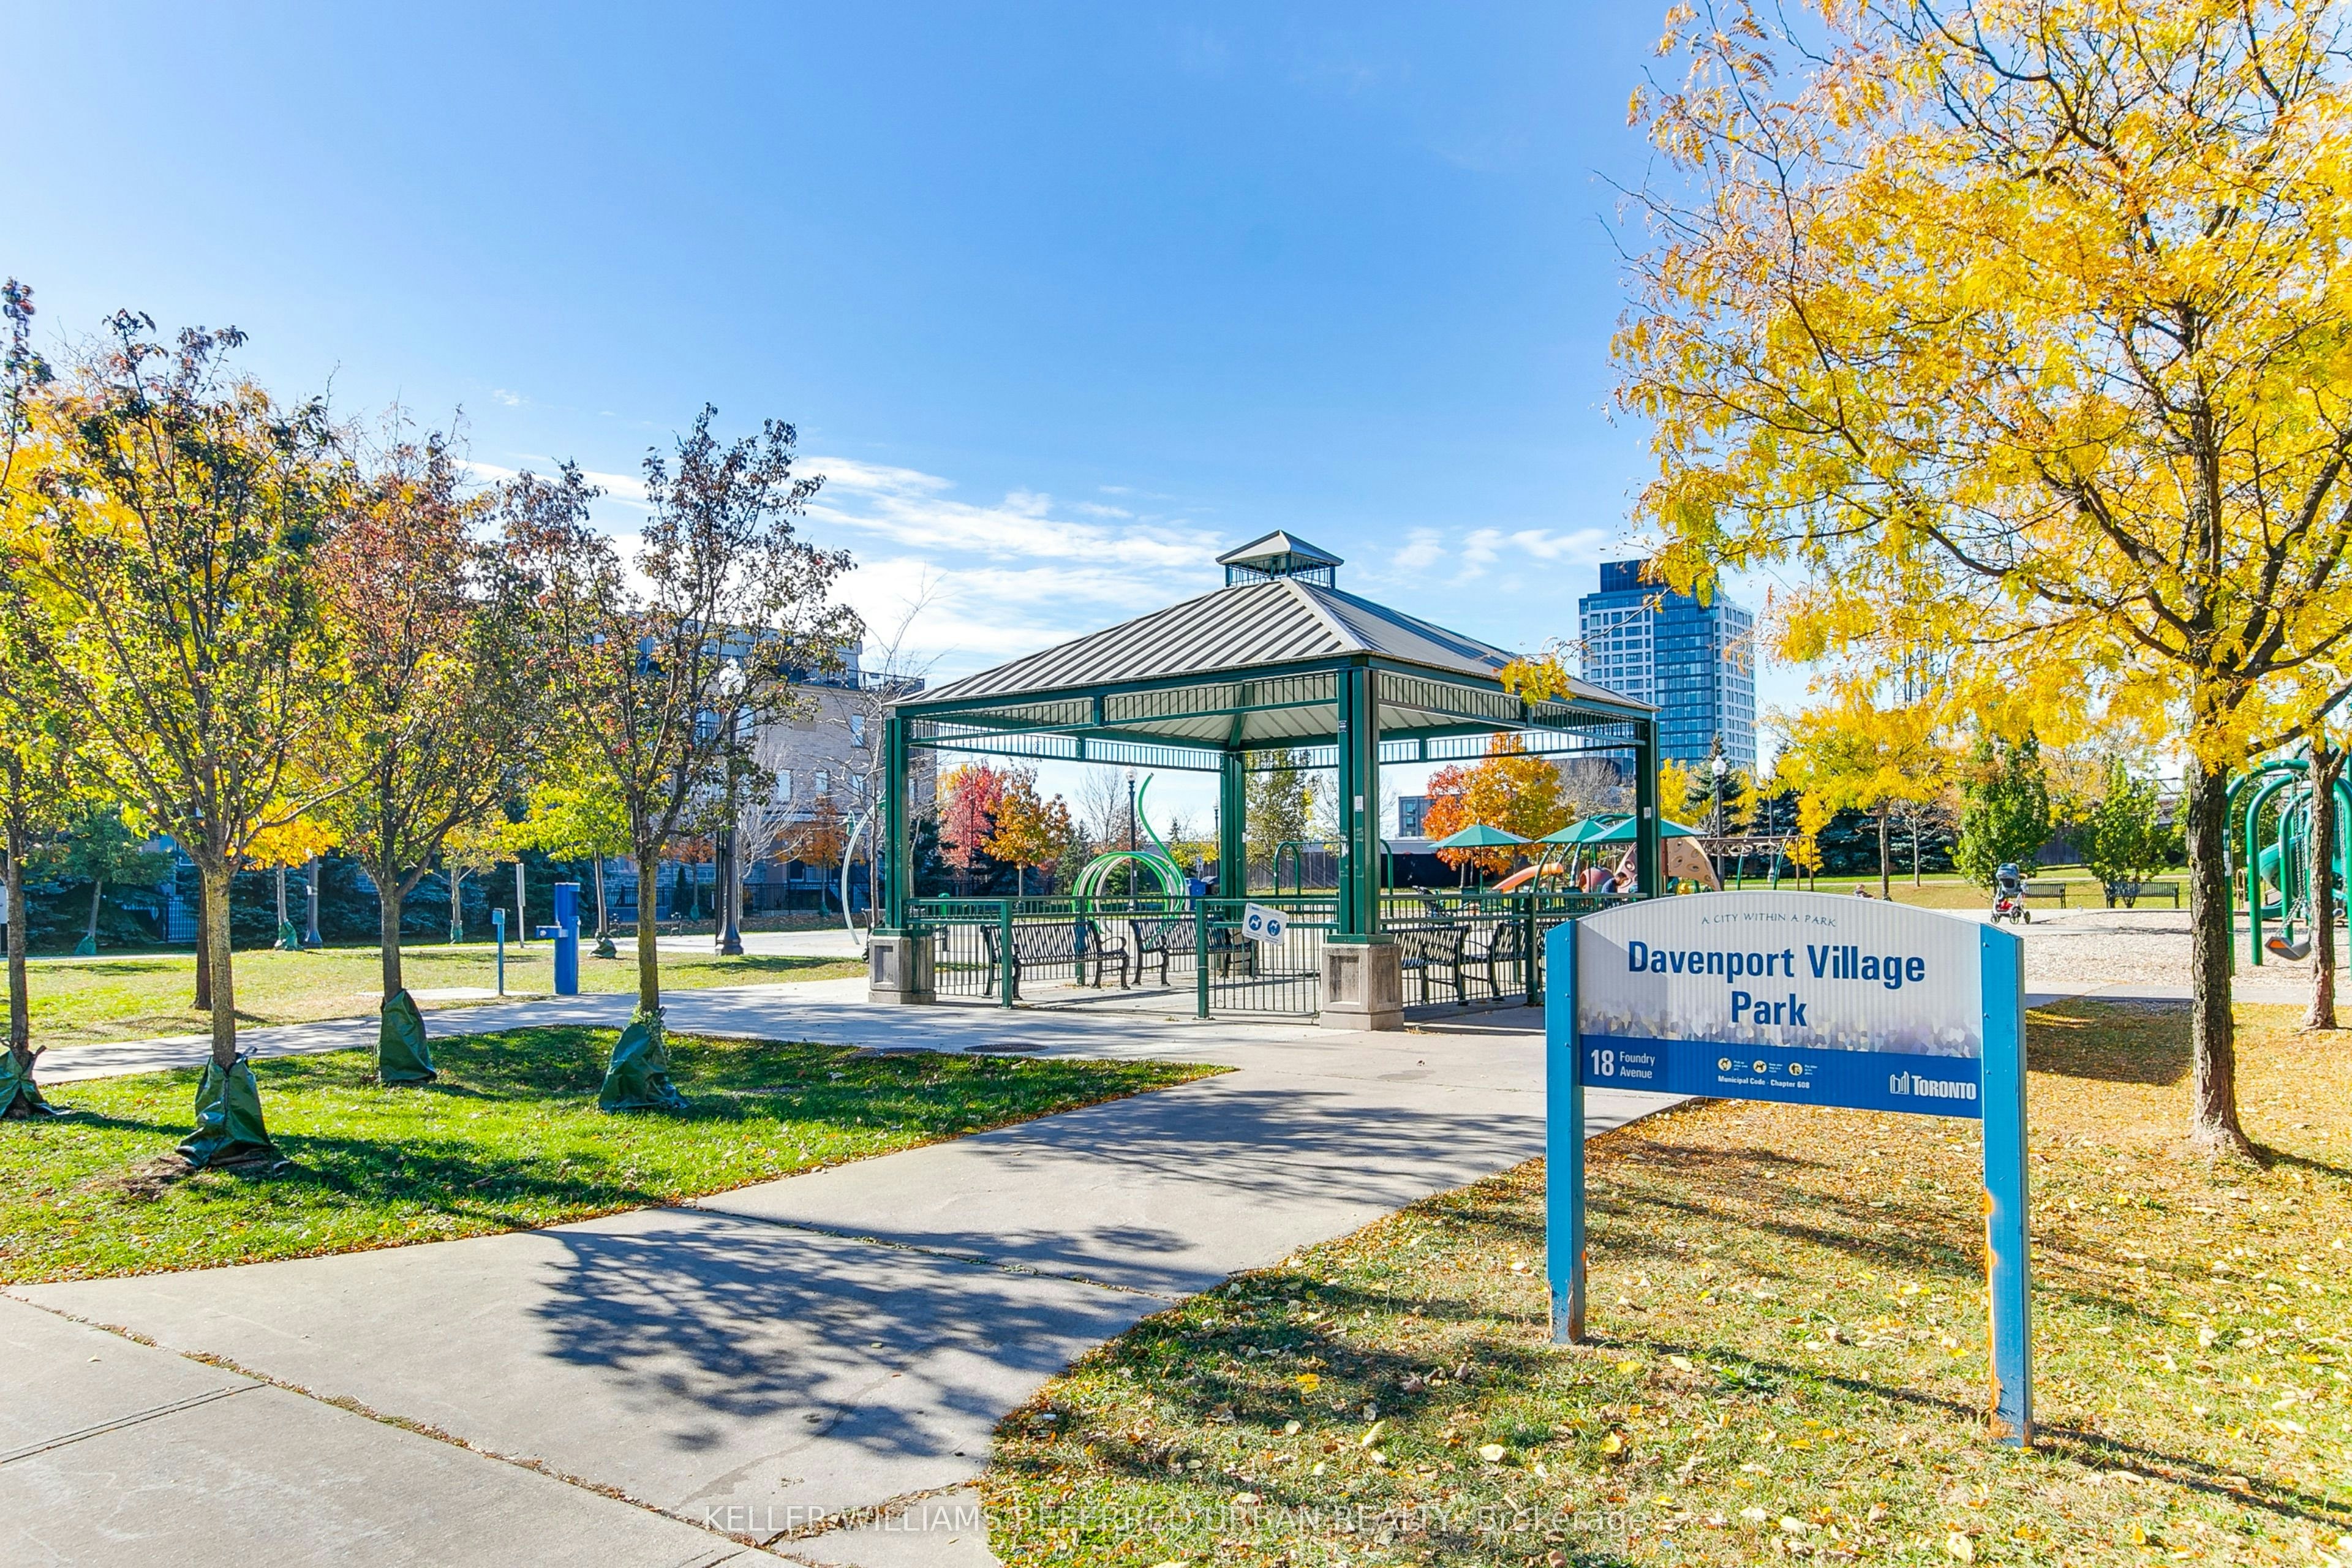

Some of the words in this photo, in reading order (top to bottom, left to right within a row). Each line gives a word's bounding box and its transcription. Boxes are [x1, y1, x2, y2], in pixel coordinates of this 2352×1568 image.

[1714, 914, 1738, 923] CITY
[1744, 913, 1785, 921] WITHIN
[1804, 915, 1836, 927] PARK
[1629, 941, 1795, 984] Davenport
[1807, 944, 1925, 990] Village
[1732, 990, 1807, 1027] Park
[1591, 1049, 1614, 1076] 18
[1619, 1051, 1655, 1066] Foundry
[1619, 1066, 1653, 1079] Avenue
[1718, 1076, 1749, 1085] Municipal
[1770, 1079, 1795, 1088] Chapter
[1911, 1075, 1977, 1101] TORONTO
